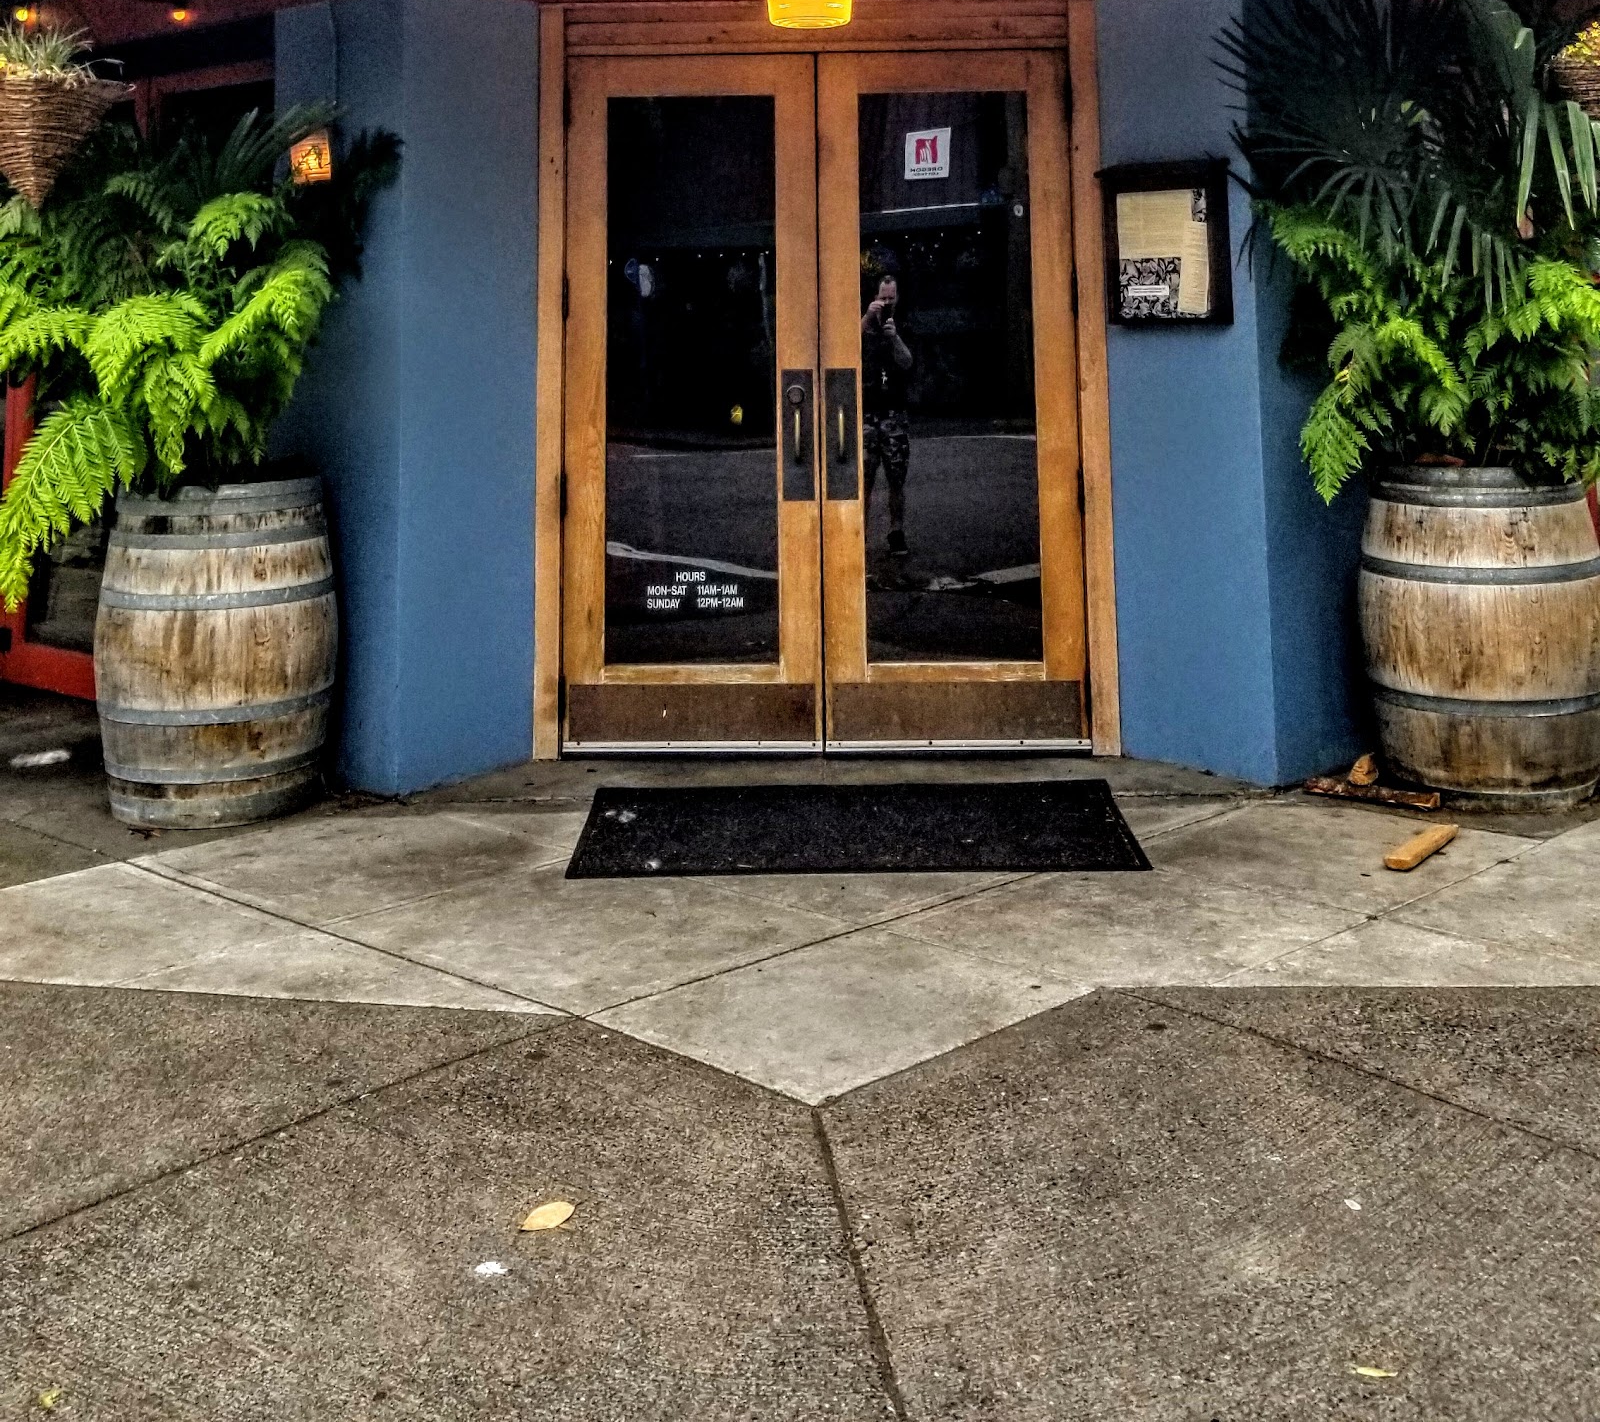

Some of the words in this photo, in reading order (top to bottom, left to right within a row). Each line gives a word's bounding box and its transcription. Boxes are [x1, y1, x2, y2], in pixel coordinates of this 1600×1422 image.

[675, 571, 706, 582] HOURS
[647, 585, 687, 596] MON-SAT
[697, 584, 738, 595] 11AM-1AM
[646, 598, 681, 609] SUNDAY
[697, 597, 744, 608] 12PM-12AM
